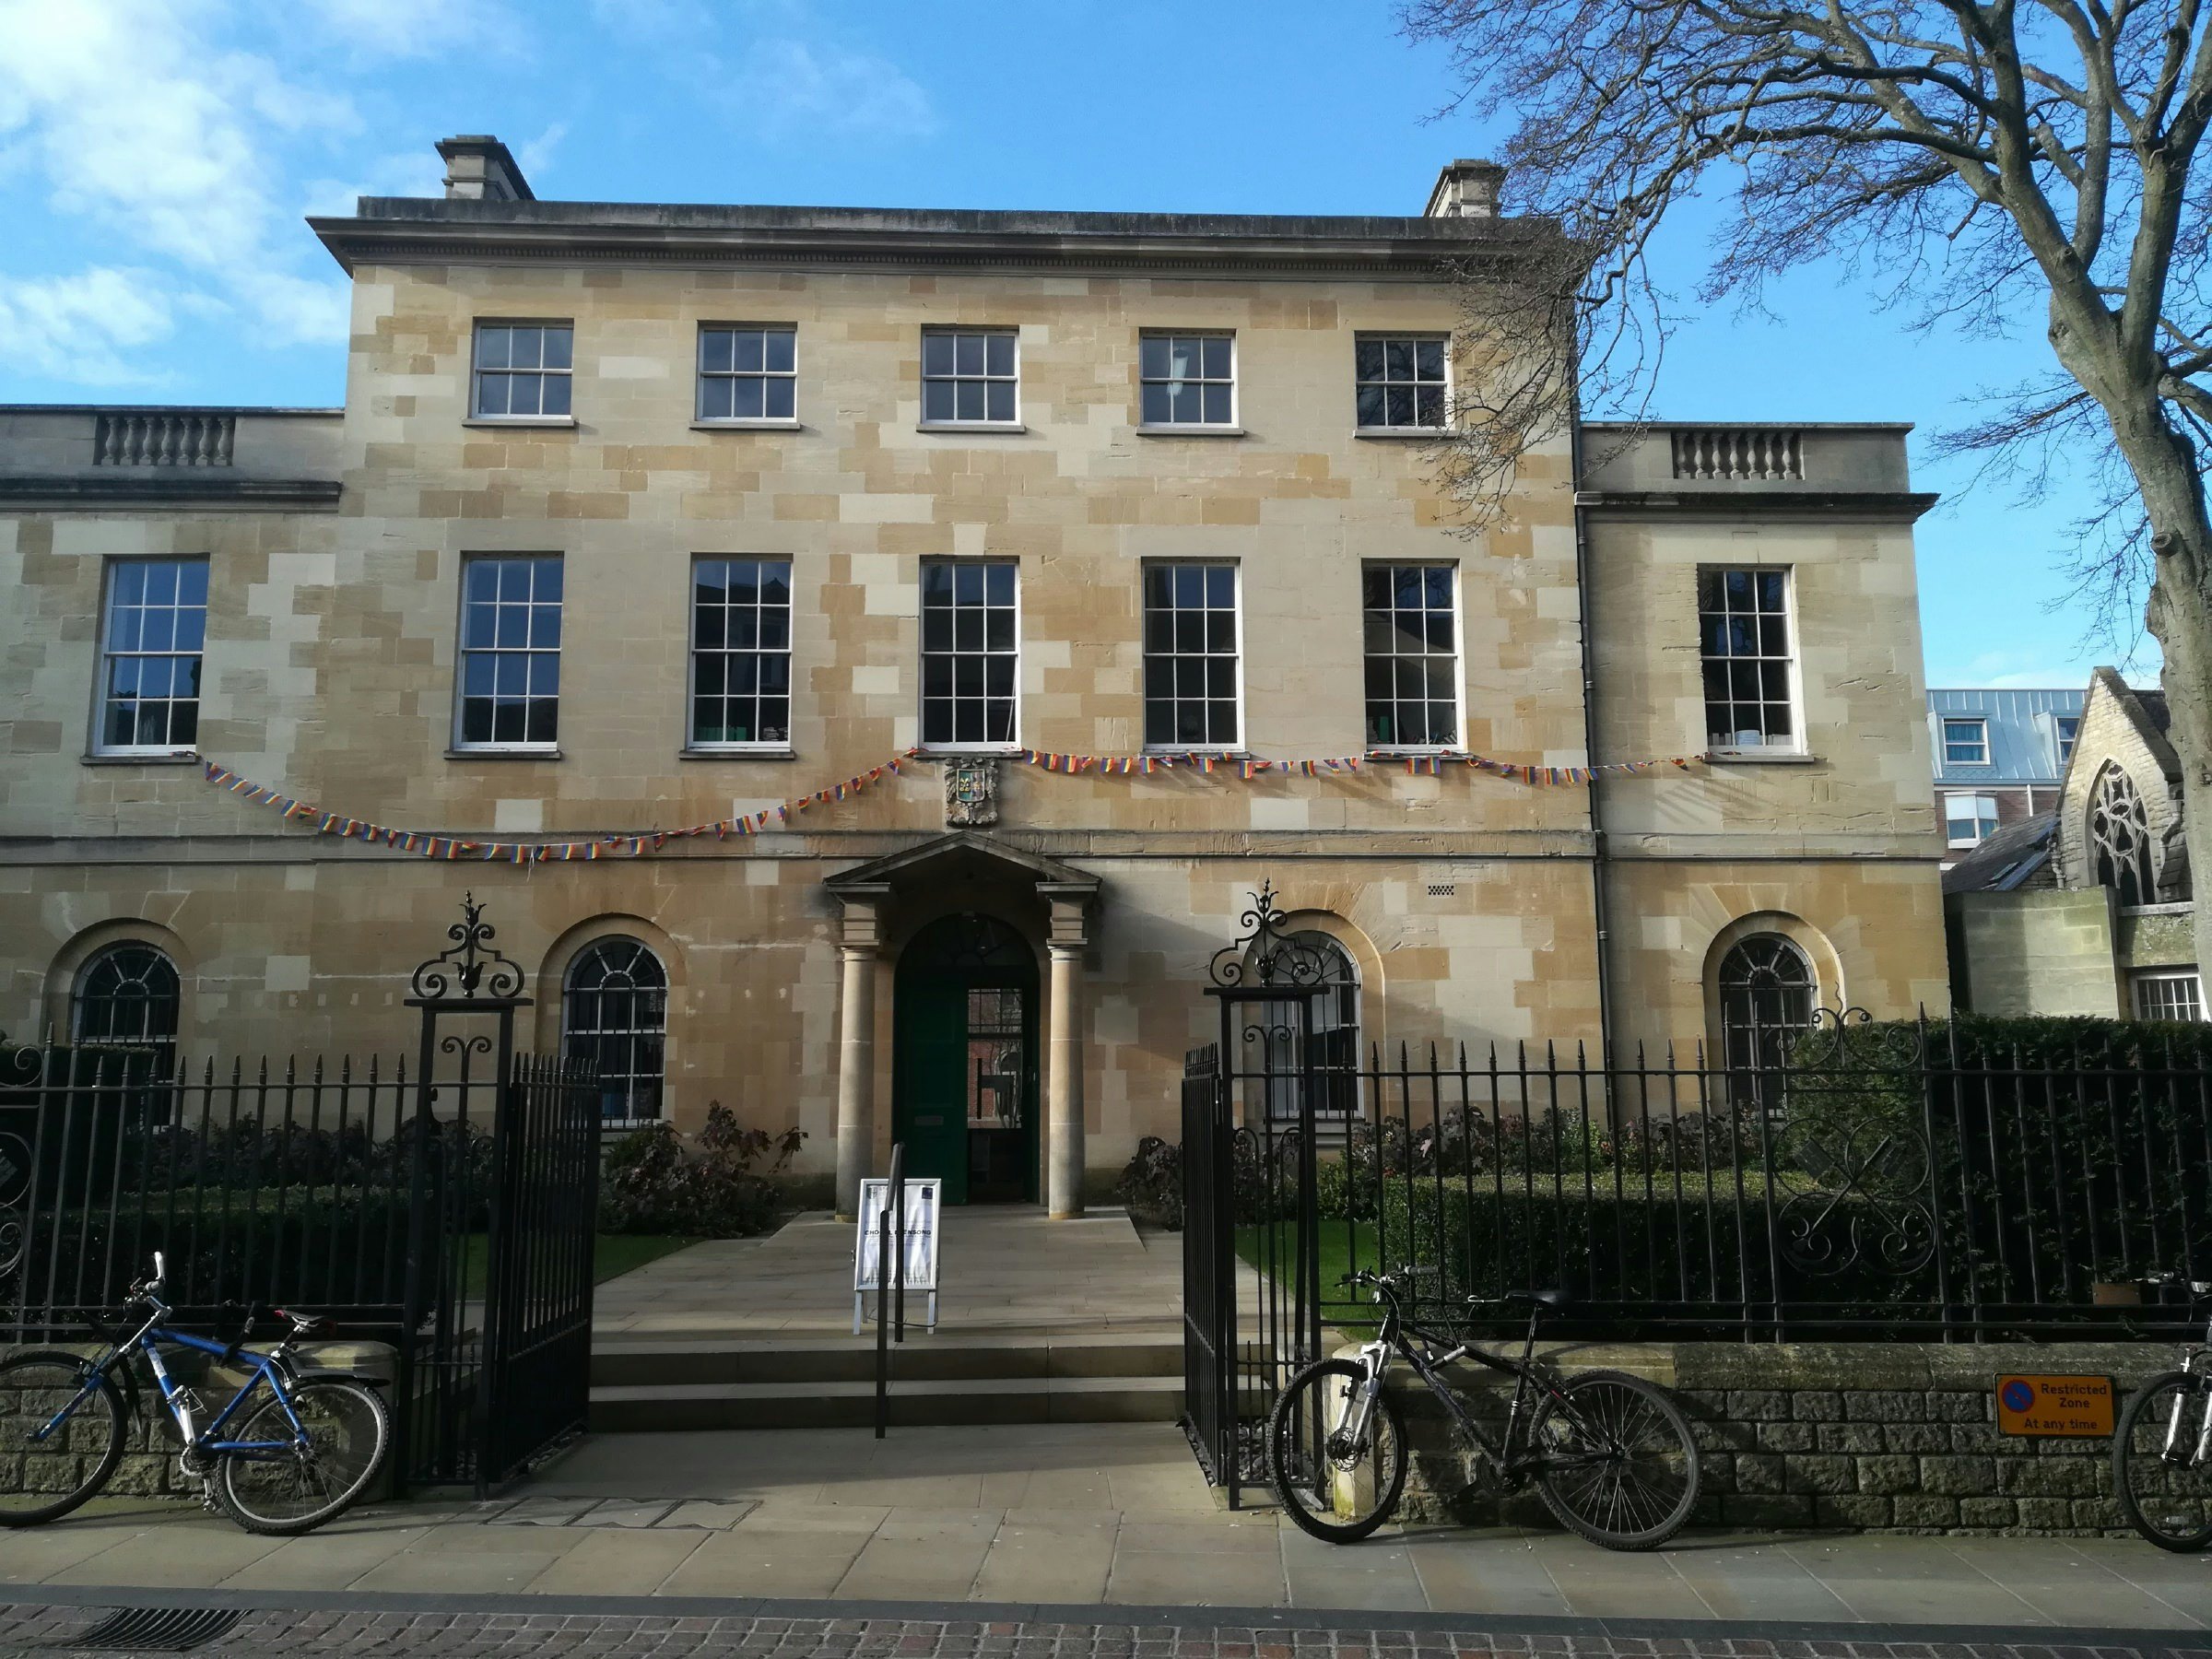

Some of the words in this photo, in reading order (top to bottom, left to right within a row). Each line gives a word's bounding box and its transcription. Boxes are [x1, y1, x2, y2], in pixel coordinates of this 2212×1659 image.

[2041, 1383, 2107, 1394] Restricted
[2059, 1397, 2090, 1408] Zone
[2024, 1418, 2039, 1429] At
[2042, 1420, 2065, 1430] any
[2069, 1418, 2098, 1430] time
